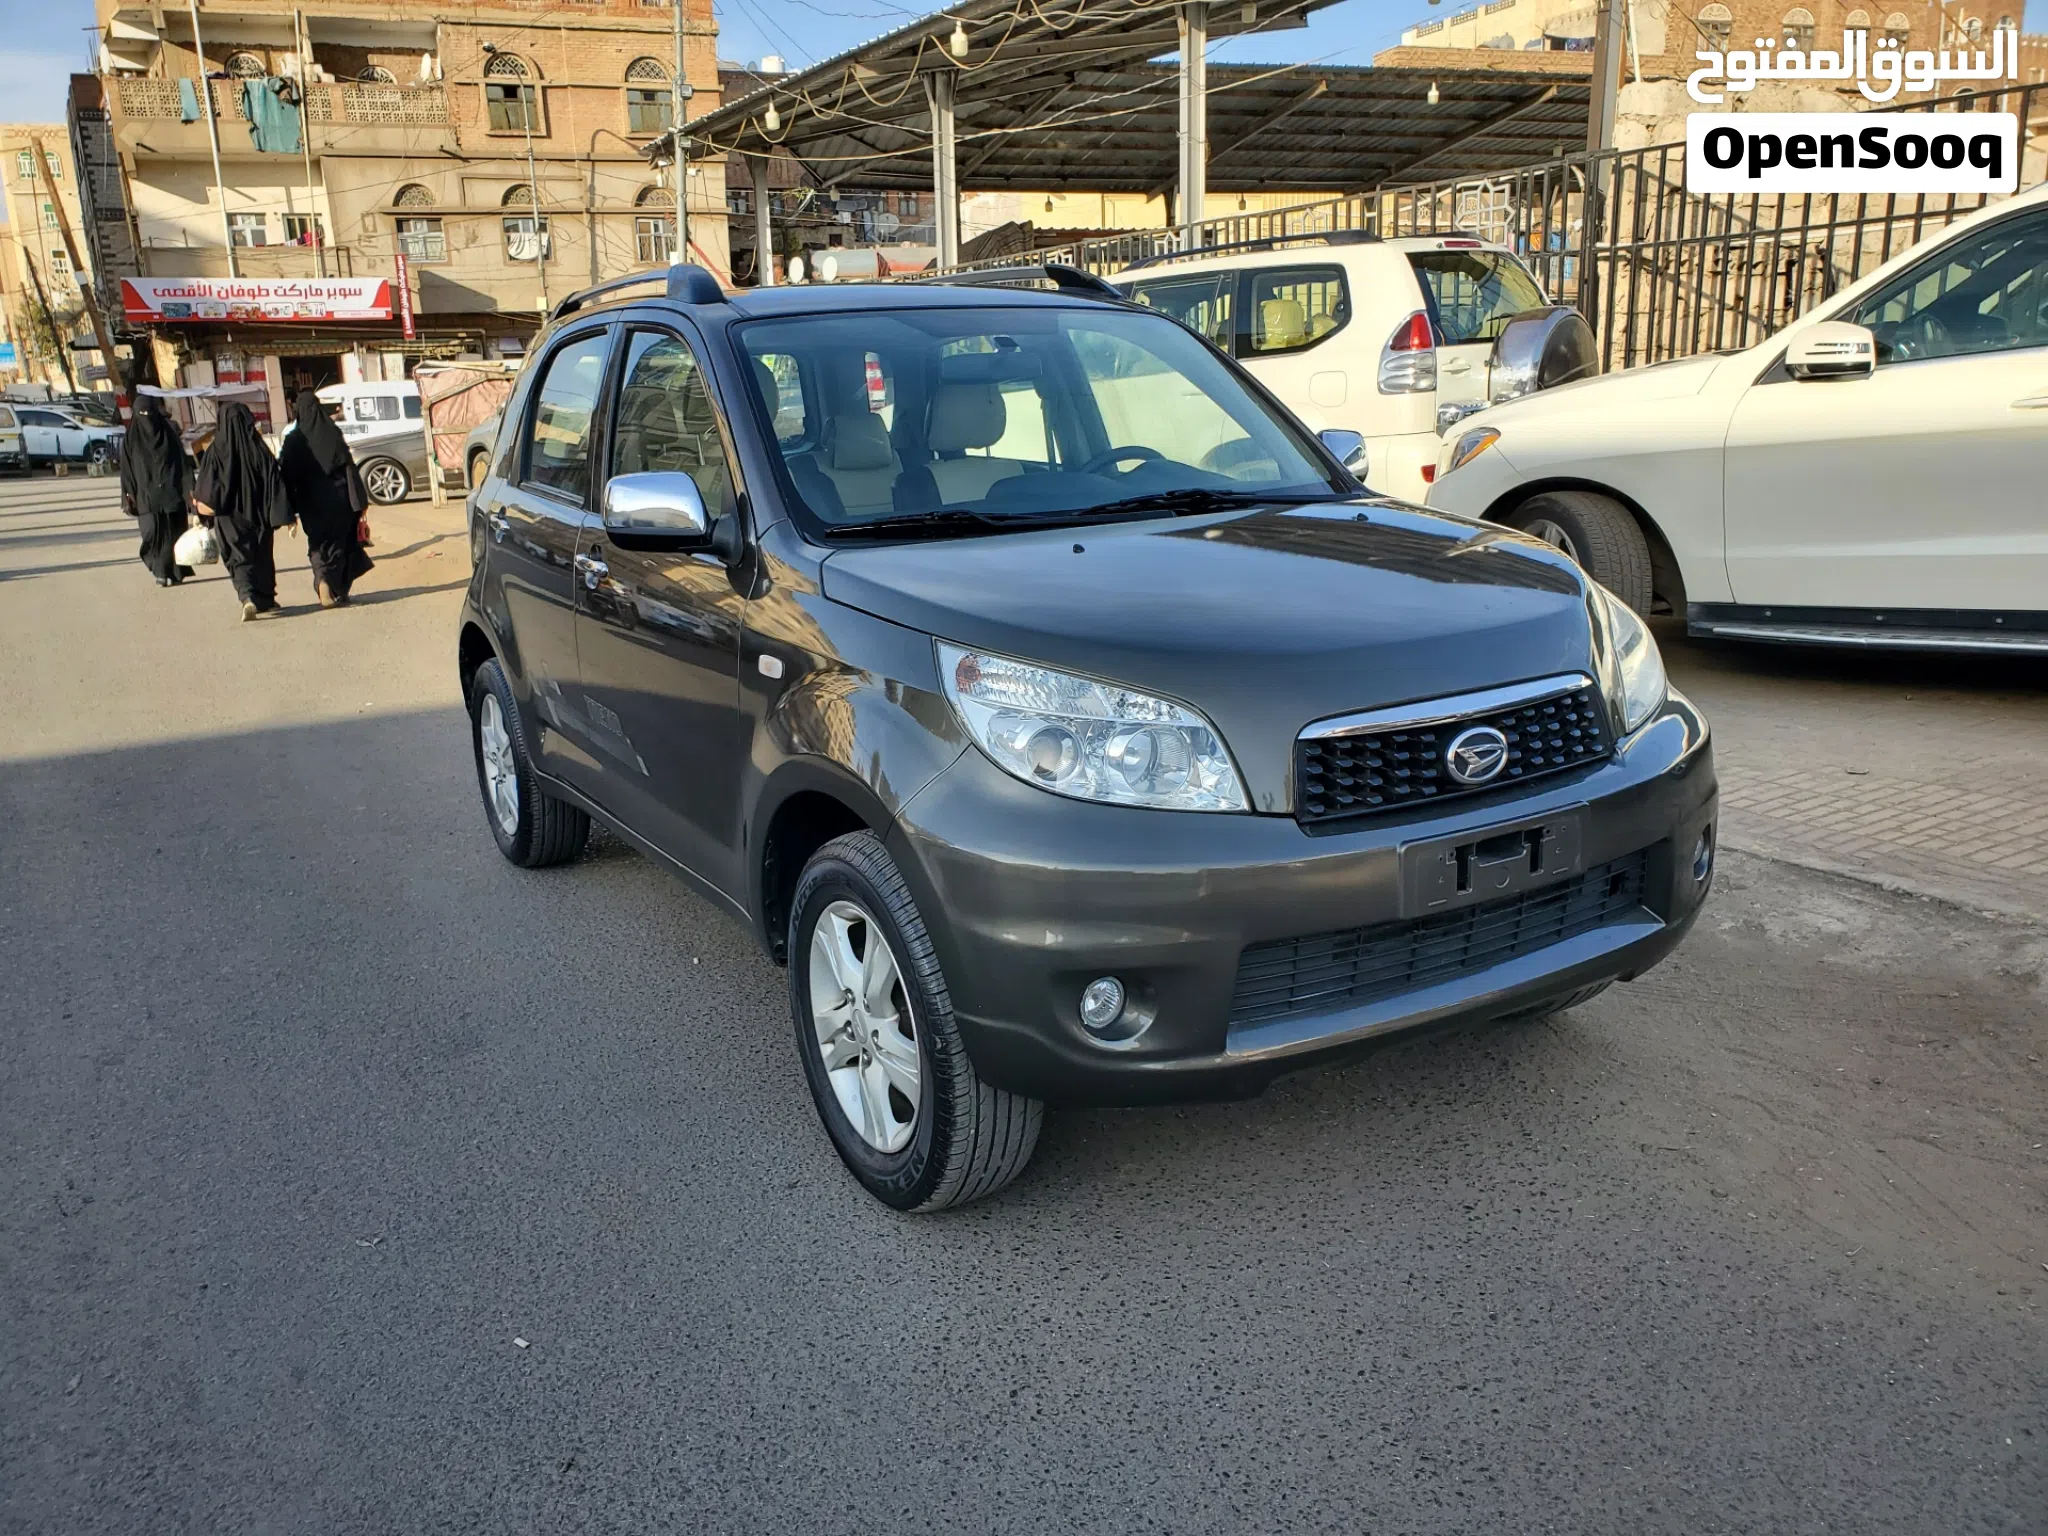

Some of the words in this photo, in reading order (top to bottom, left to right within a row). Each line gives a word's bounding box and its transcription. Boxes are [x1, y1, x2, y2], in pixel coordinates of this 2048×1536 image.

[153, 281, 212, 297] الأقصى
[217, 285, 269, 301] طوفان
[274, 283, 323, 300] ماركت
[327, 287, 362, 300] سوبر
